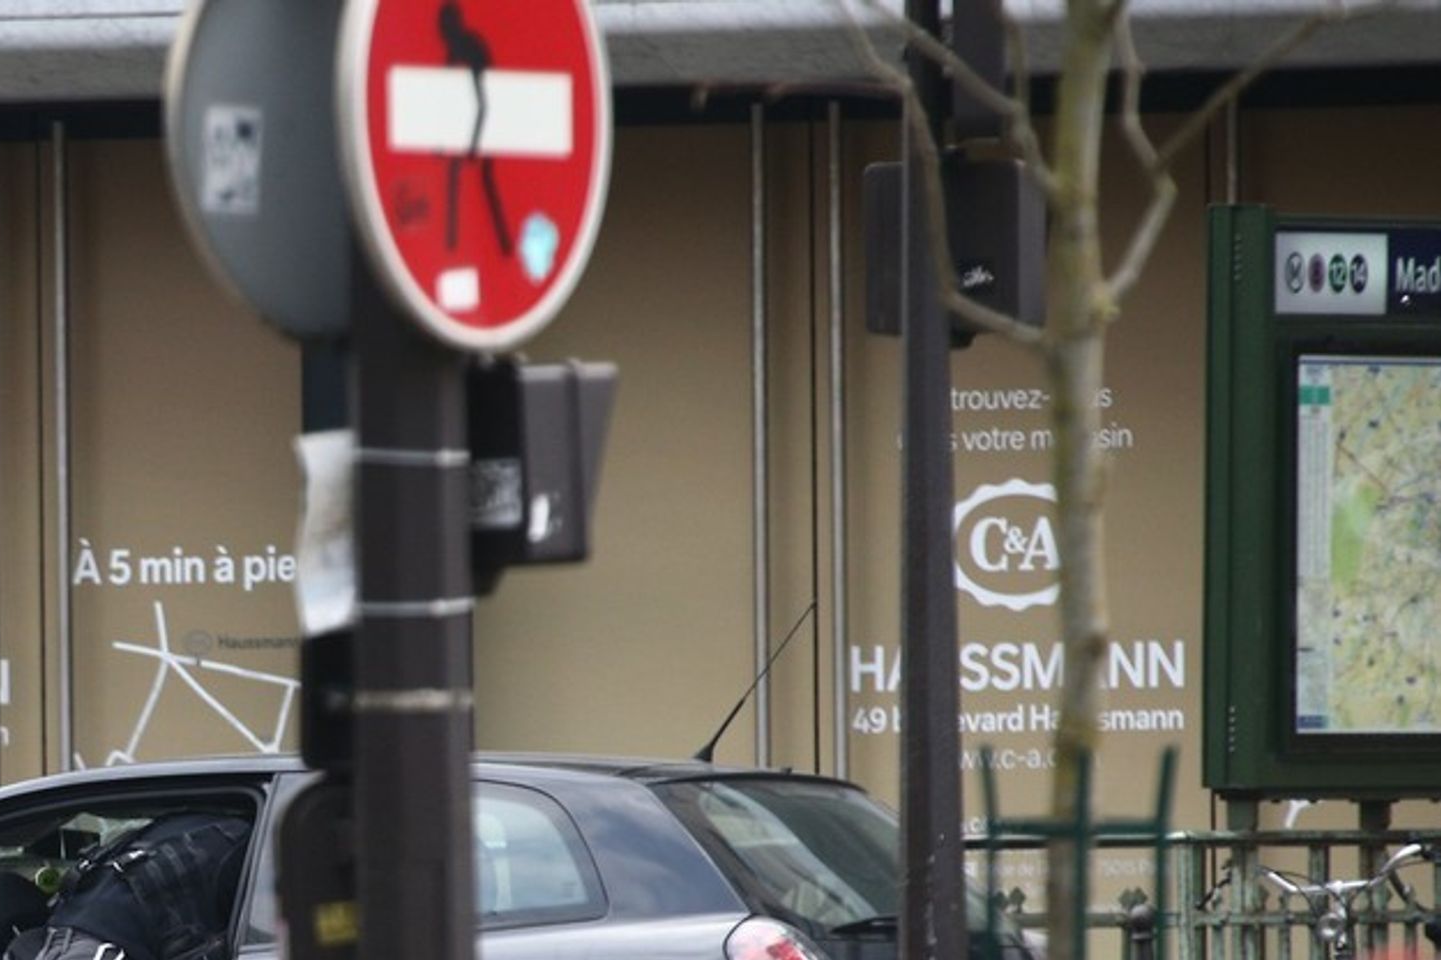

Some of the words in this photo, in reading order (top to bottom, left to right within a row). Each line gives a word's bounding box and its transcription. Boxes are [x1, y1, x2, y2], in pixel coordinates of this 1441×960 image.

[1396, 256, 1440, 294] Mad
[961, 428, 1026, 451] votre
[1030, 422, 1134, 450] msin
[73, 538, 101, 585] À
[109, 549, 132, 585] 5
[140, 546, 205, 584] min
[213, 545, 235, 583] à
[243, 545, 297, 592] pie
[969, 516, 1061, 572] C&A
[850, 640, 1185, 693] HSSMNN
[852, 707, 887, 734] 49
[1030, 703, 1185, 731] Hasmann
